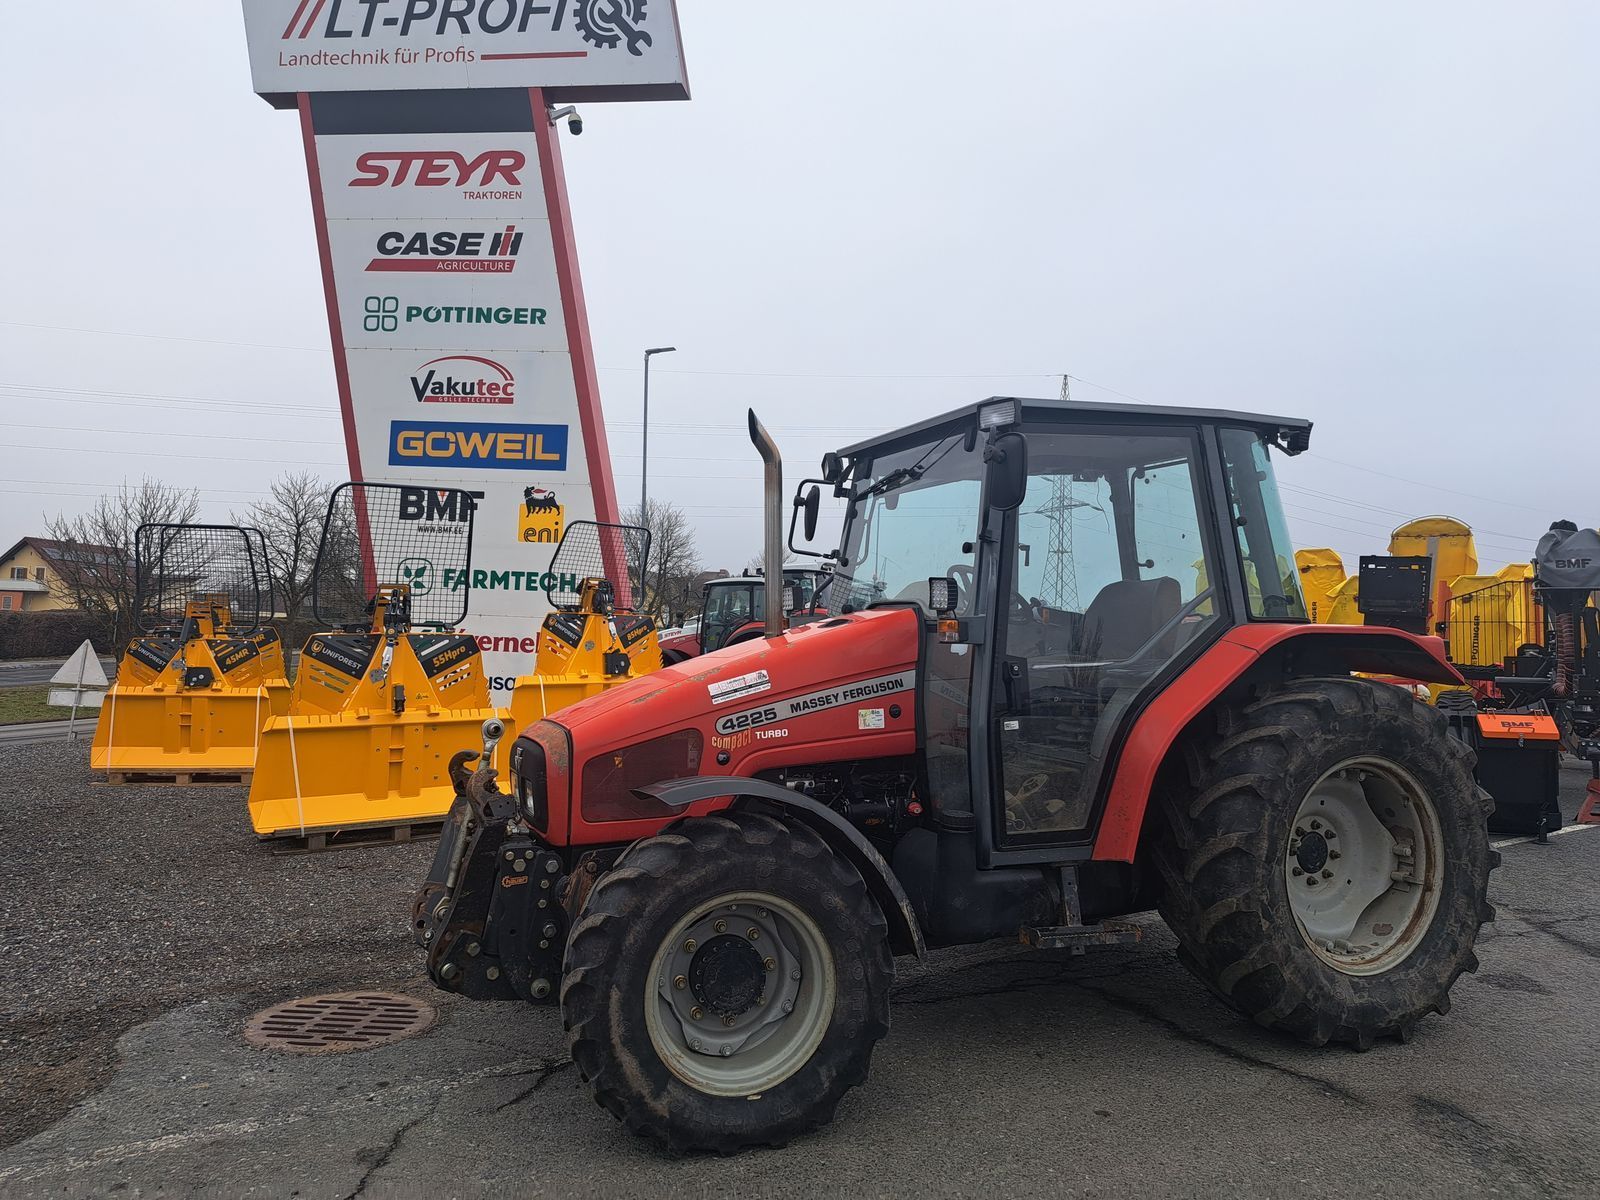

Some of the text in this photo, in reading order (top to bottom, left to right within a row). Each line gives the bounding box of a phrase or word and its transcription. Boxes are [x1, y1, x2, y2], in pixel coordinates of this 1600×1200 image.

[279, 46, 475, 67] Landtechnik für Profis
[348, 150, 526, 187] STEYR
[463, 191, 522, 200] TRAKTOREN
[376, 231, 485, 256] CASE
[436, 261, 511, 271] AGRICULTURE
[410, 370, 515, 402] Vakutec
[399, 488, 485, 522] BMF
[524, 521, 560, 543] eni
[1555, 558, 1592, 569] BMF
[443, 568, 577, 592] FARMTECH
[554, 622, 579, 641] UNIFOREST
[138, 646, 166, 667] UNIFOREST
[225, 648, 250, 665] 45MR
[322, 647, 363, 670] UNIFOREST
[432, 645, 466, 667] 55Hpro
[721, 708, 778, 731] 4225
[790, 692, 839, 714] MASSEY
[843, 678, 904, 700] FERGUSON
[755, 729, 789, 740] TURBO
